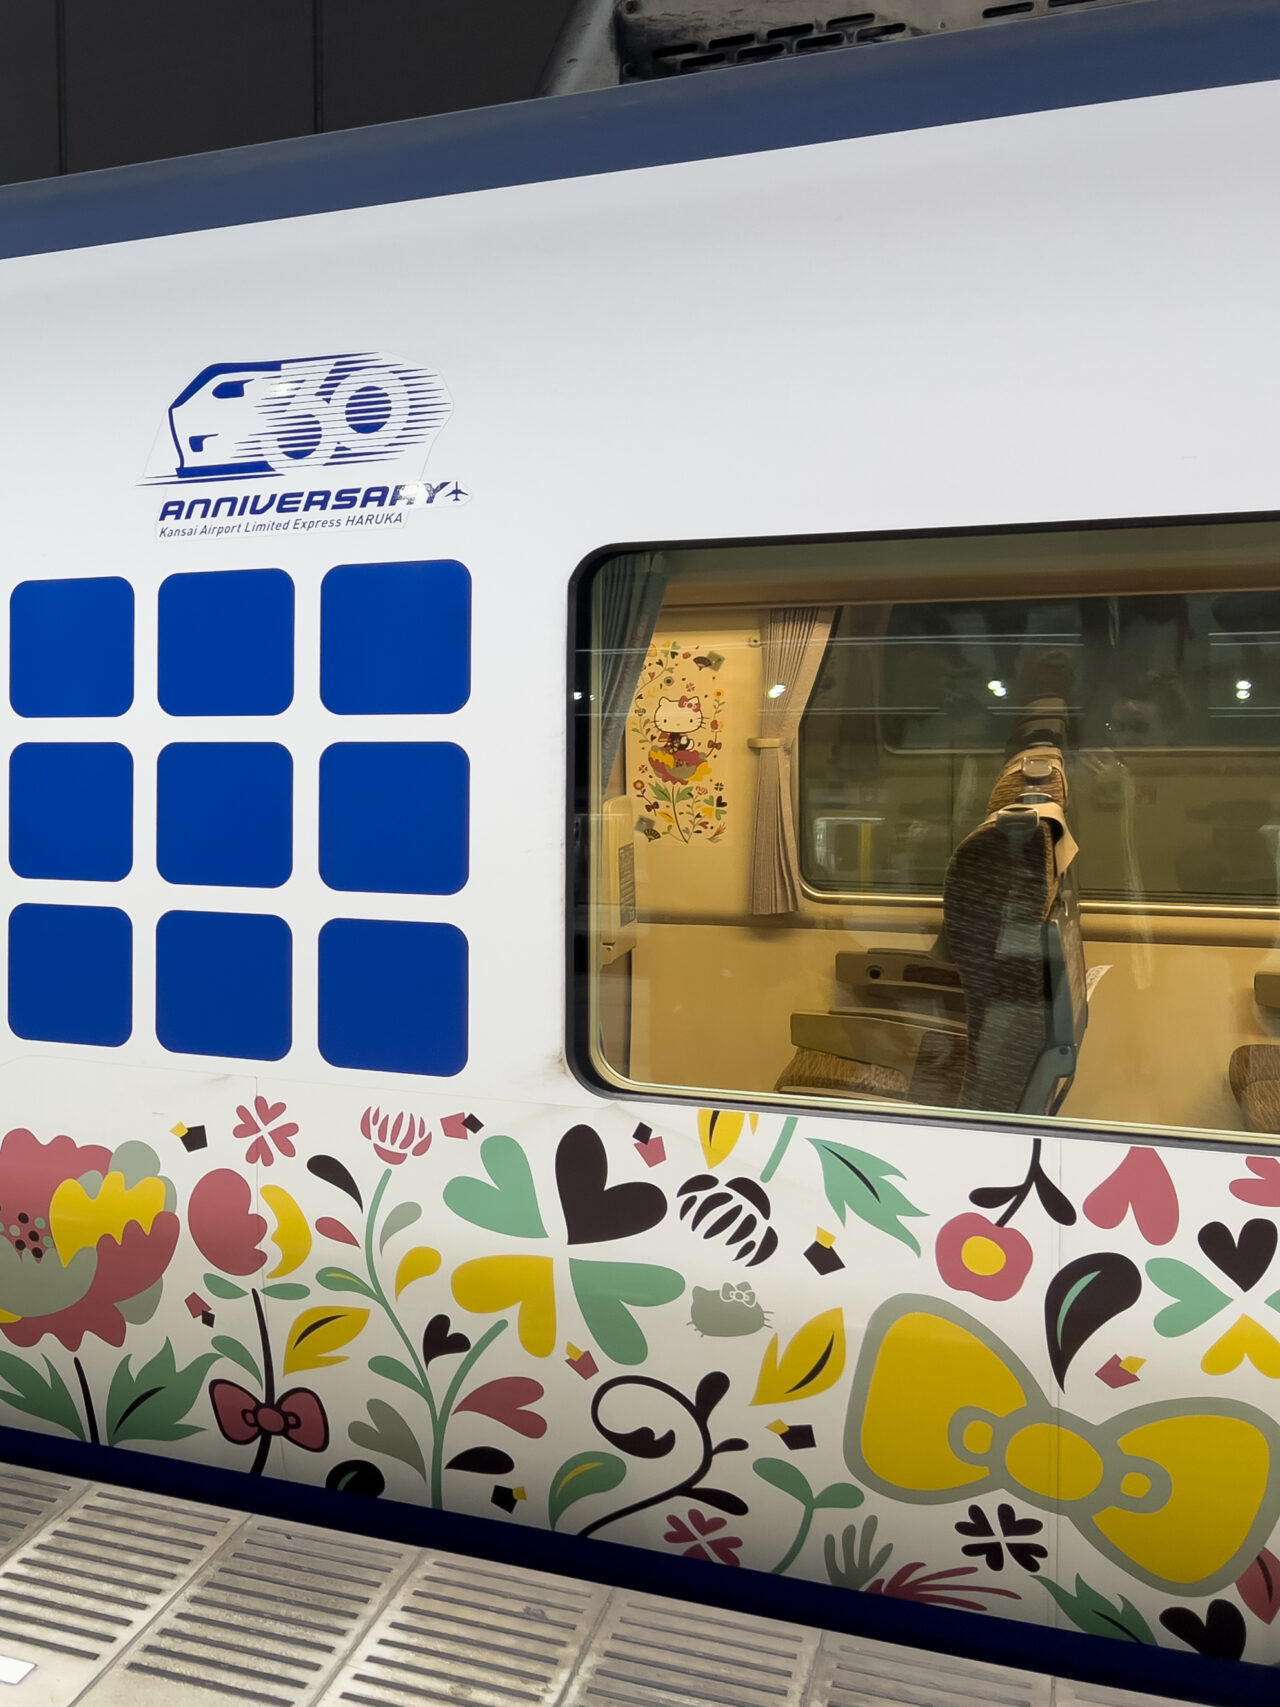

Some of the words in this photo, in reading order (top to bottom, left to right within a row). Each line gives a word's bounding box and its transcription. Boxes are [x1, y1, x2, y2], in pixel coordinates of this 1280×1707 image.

[159, 526, 197, 538] Kansai
[199, 522, 242, 537] Airport
[244, 519, 291, 533] Limited
[292, 517, 342, 531] Express
[345, 512, 403, 527] HARUKA
